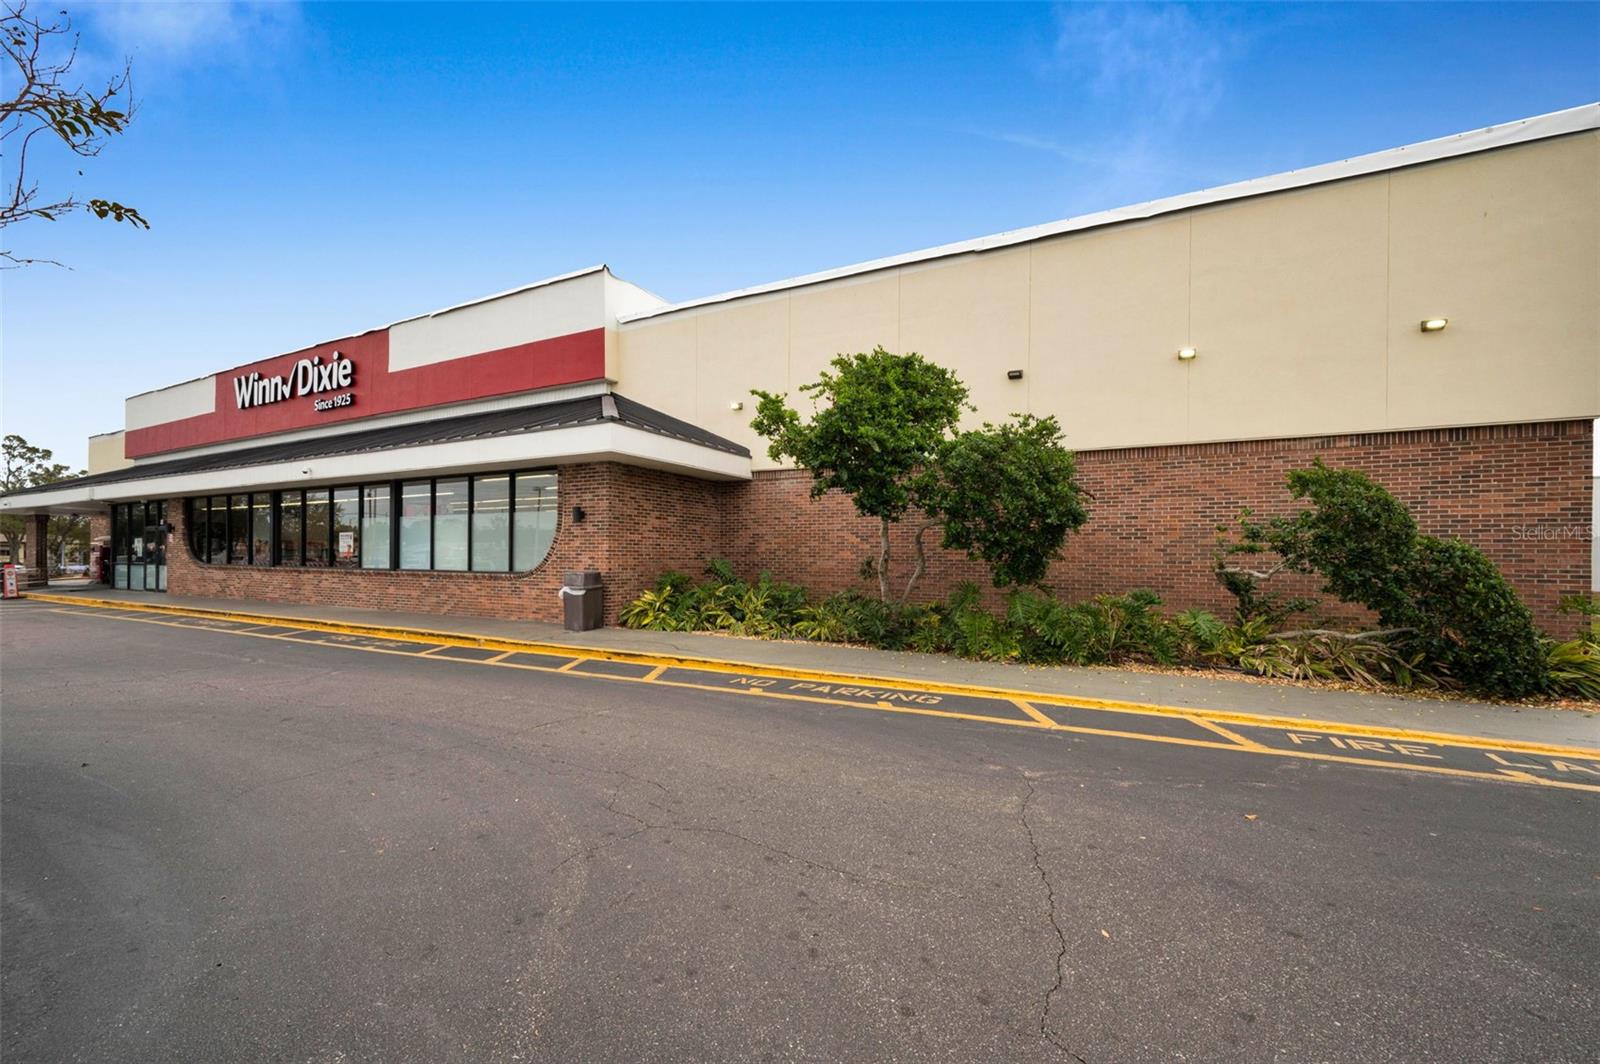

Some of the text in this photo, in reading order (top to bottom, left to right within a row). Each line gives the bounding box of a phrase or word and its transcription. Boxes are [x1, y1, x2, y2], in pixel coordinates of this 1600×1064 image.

[233, 351, 352, 409] Winn Dixie
[314, 393, 351, 411] Since 1925
[729, 677, 943, 705] NO PARKING
[1286, 732, 1600, 775] FIRE LA
